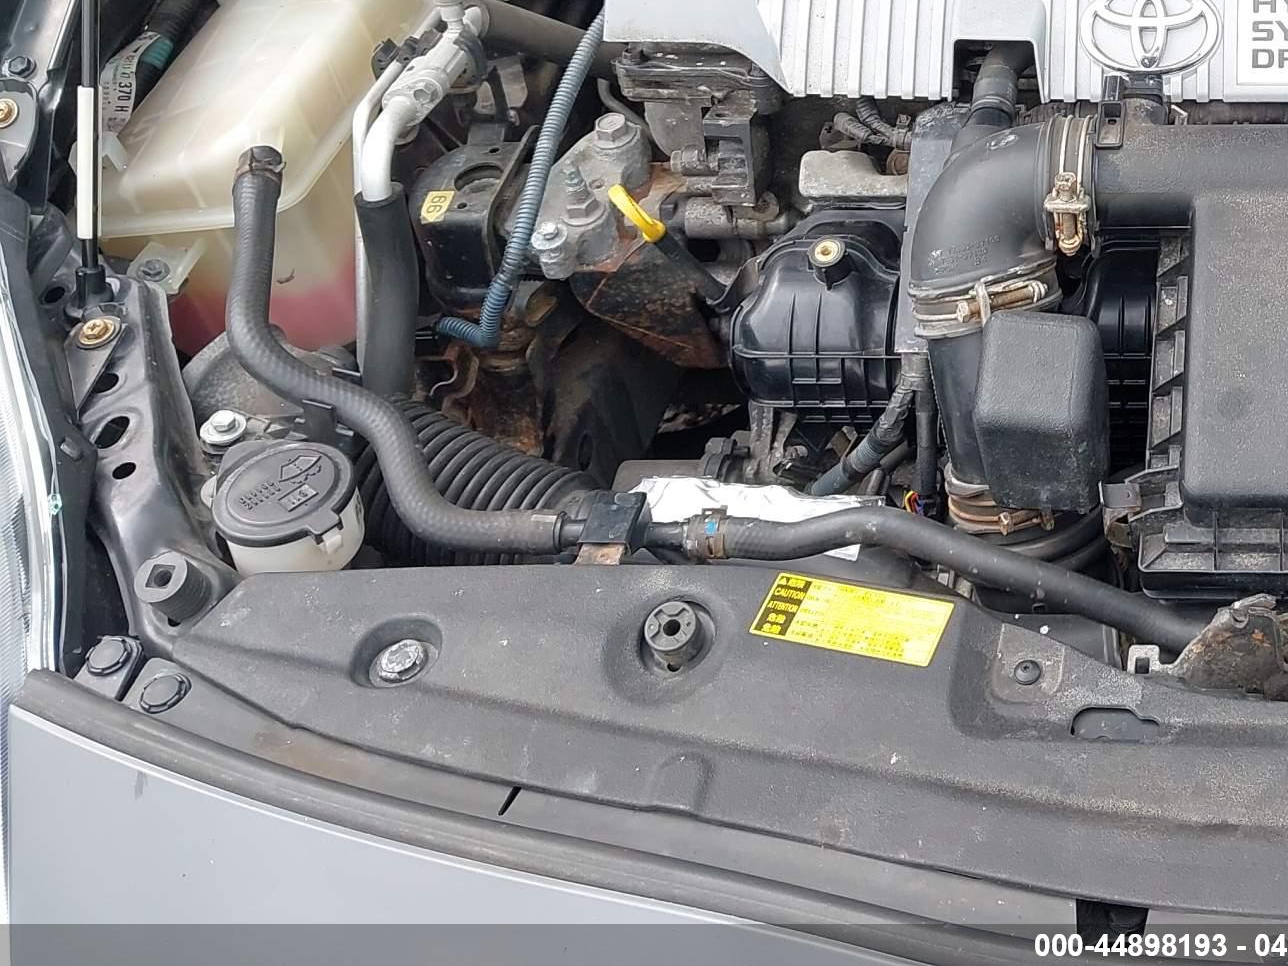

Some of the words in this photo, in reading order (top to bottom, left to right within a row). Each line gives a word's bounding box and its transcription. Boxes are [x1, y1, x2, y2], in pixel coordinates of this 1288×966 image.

[117, 81, 133, 101] 370
[114, 105, 130, 113] H
[774, 587, 806, 601] CAUTION
[767, 600, 799, 614] ATTENTION
